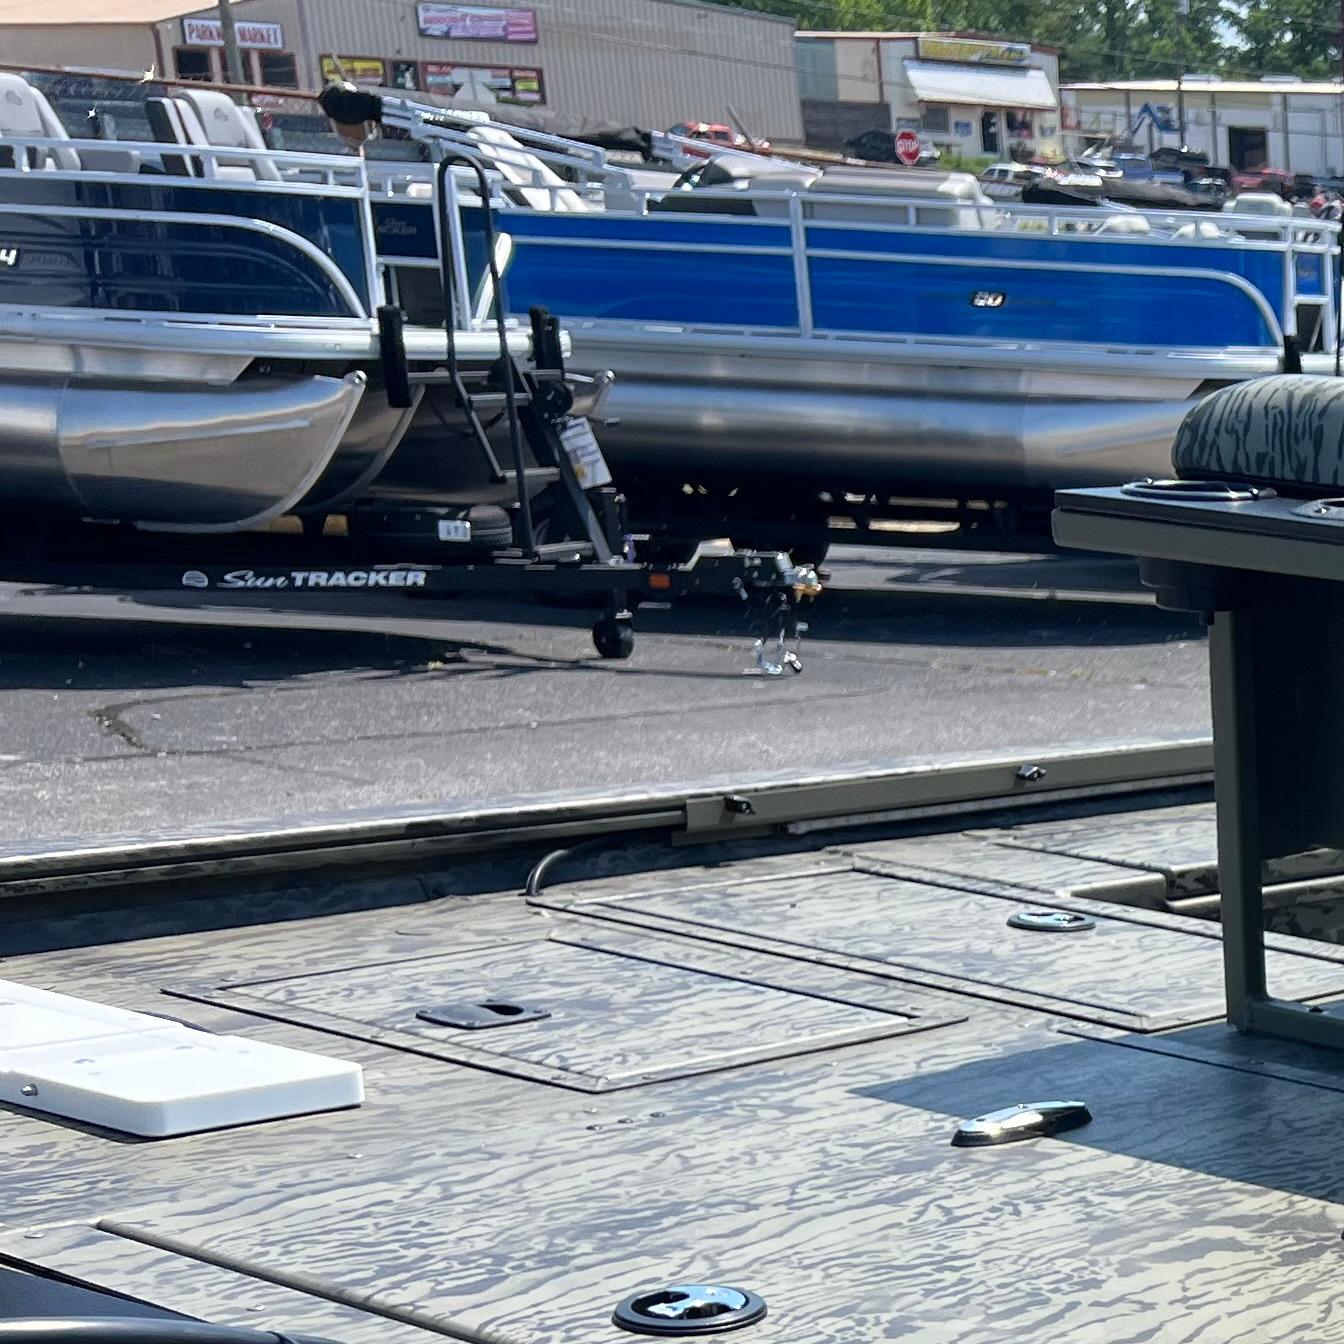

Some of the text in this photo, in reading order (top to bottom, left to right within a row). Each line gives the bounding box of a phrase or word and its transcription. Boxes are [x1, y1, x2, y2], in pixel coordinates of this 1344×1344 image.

[897, 140, 919, 152] STOP
[217, 570, 427, 589] Sun TRACKER
